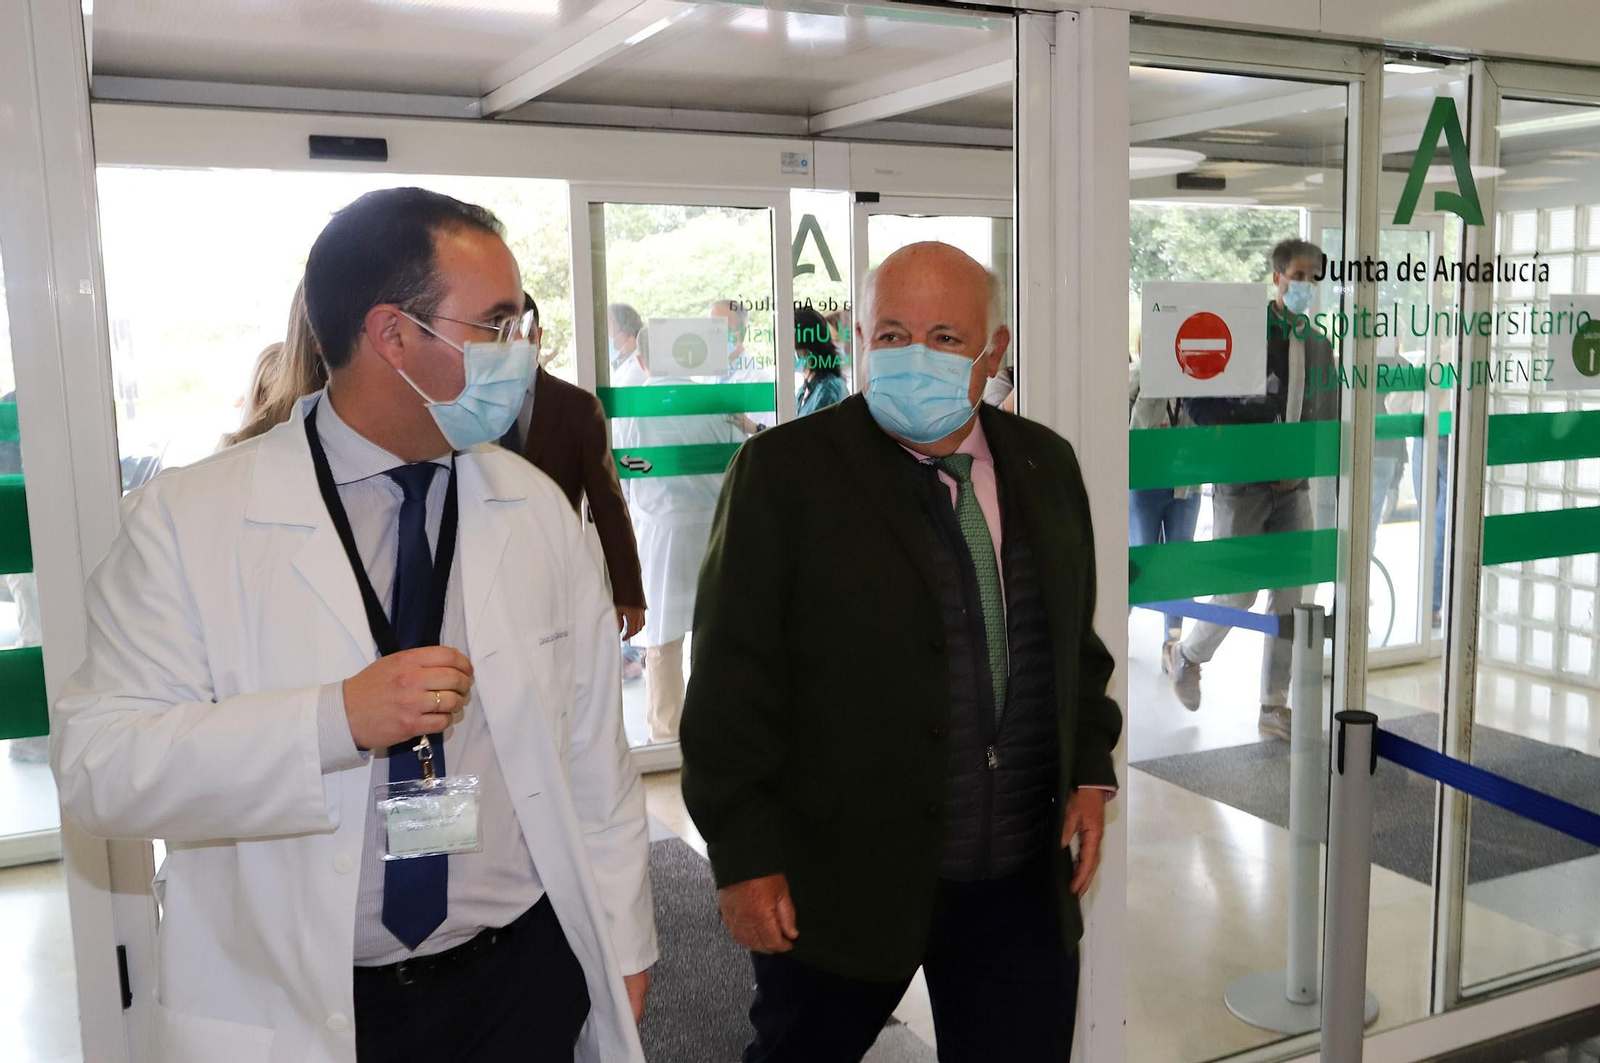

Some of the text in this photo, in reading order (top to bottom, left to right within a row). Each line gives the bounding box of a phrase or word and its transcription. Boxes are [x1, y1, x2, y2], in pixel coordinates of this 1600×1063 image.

[1313, 250, 1550, 283] Junta de Andalucía
[1266, 302, 1591, 350] Hospital Universitario
[1304, 352, 1556, 398] JUAN RAMÓN JIMÉNEZ
